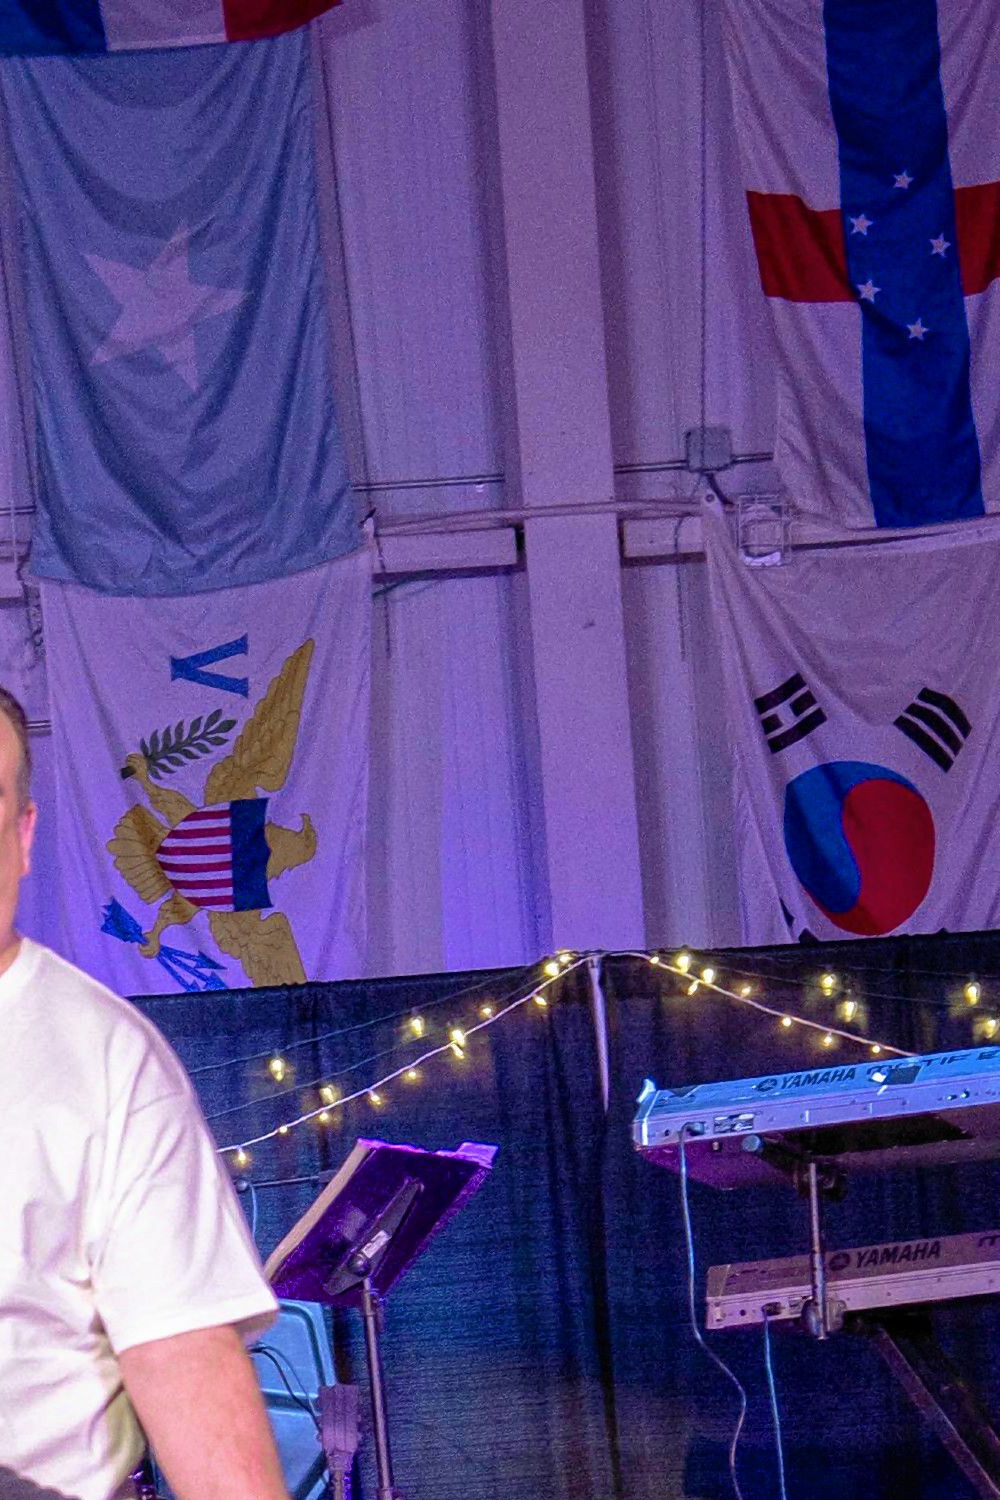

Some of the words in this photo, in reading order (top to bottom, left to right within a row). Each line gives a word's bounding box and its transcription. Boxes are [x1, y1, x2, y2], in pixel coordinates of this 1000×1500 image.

[170, 632, 249, 699] V
[781, 1067, 856, 1089] YAMAHA
[856, 1240, 941, 1268] YAMAHA
